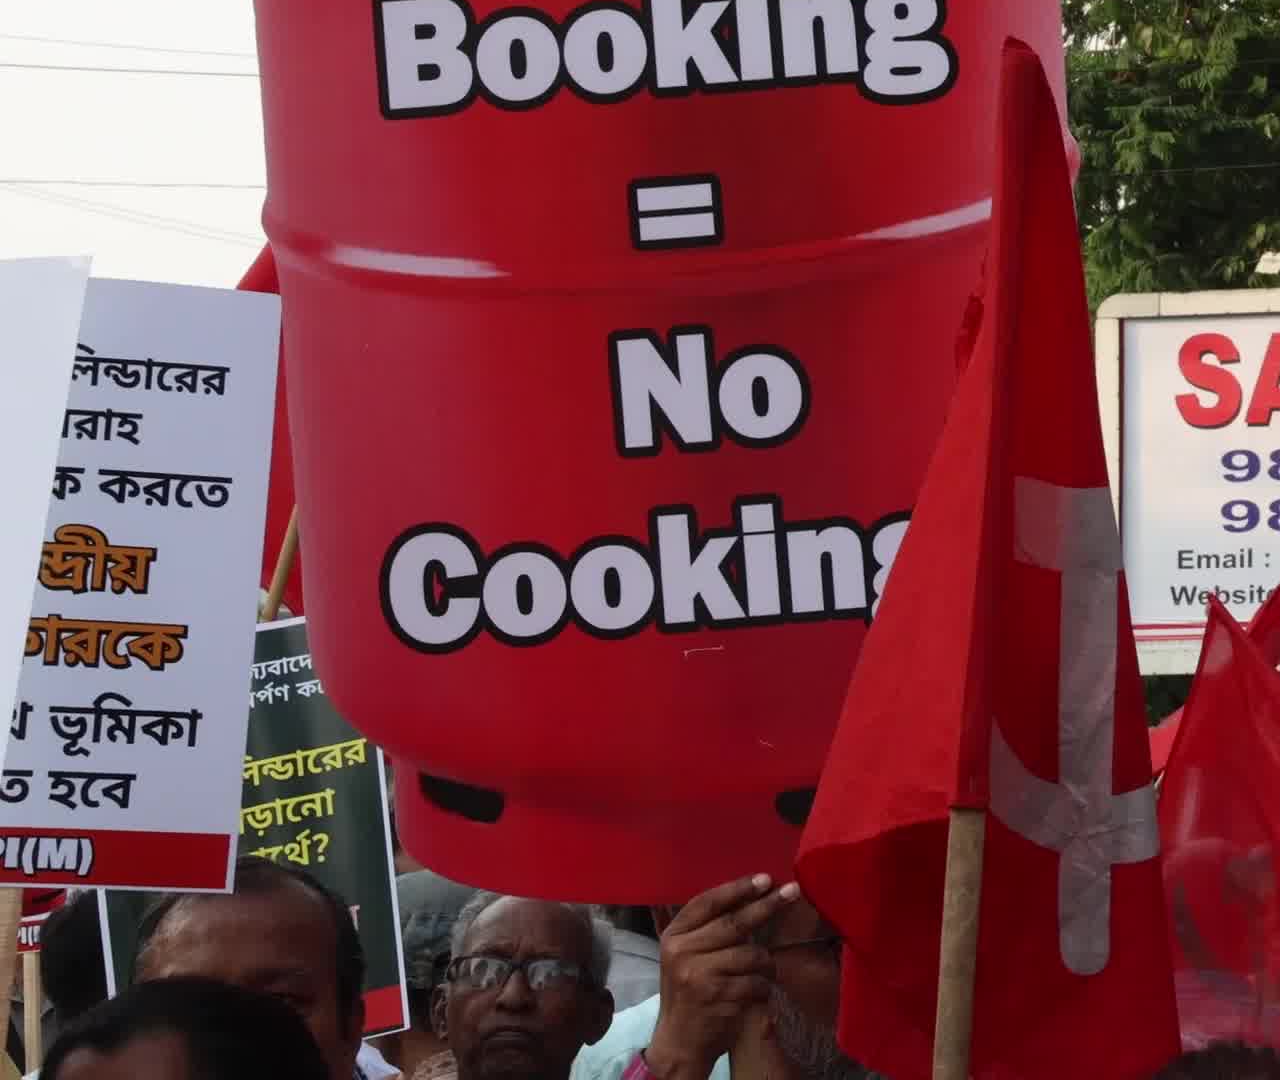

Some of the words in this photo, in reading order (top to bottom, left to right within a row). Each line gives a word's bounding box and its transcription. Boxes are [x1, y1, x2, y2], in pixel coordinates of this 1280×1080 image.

[608, 324, 811, 458] No
[98, 469, 232, 508] করতে
[1177, 547, 1253, 570] Email
[49, 692, 203, 757] ভূমিকা
[48, 770, 137, 810] হবে
